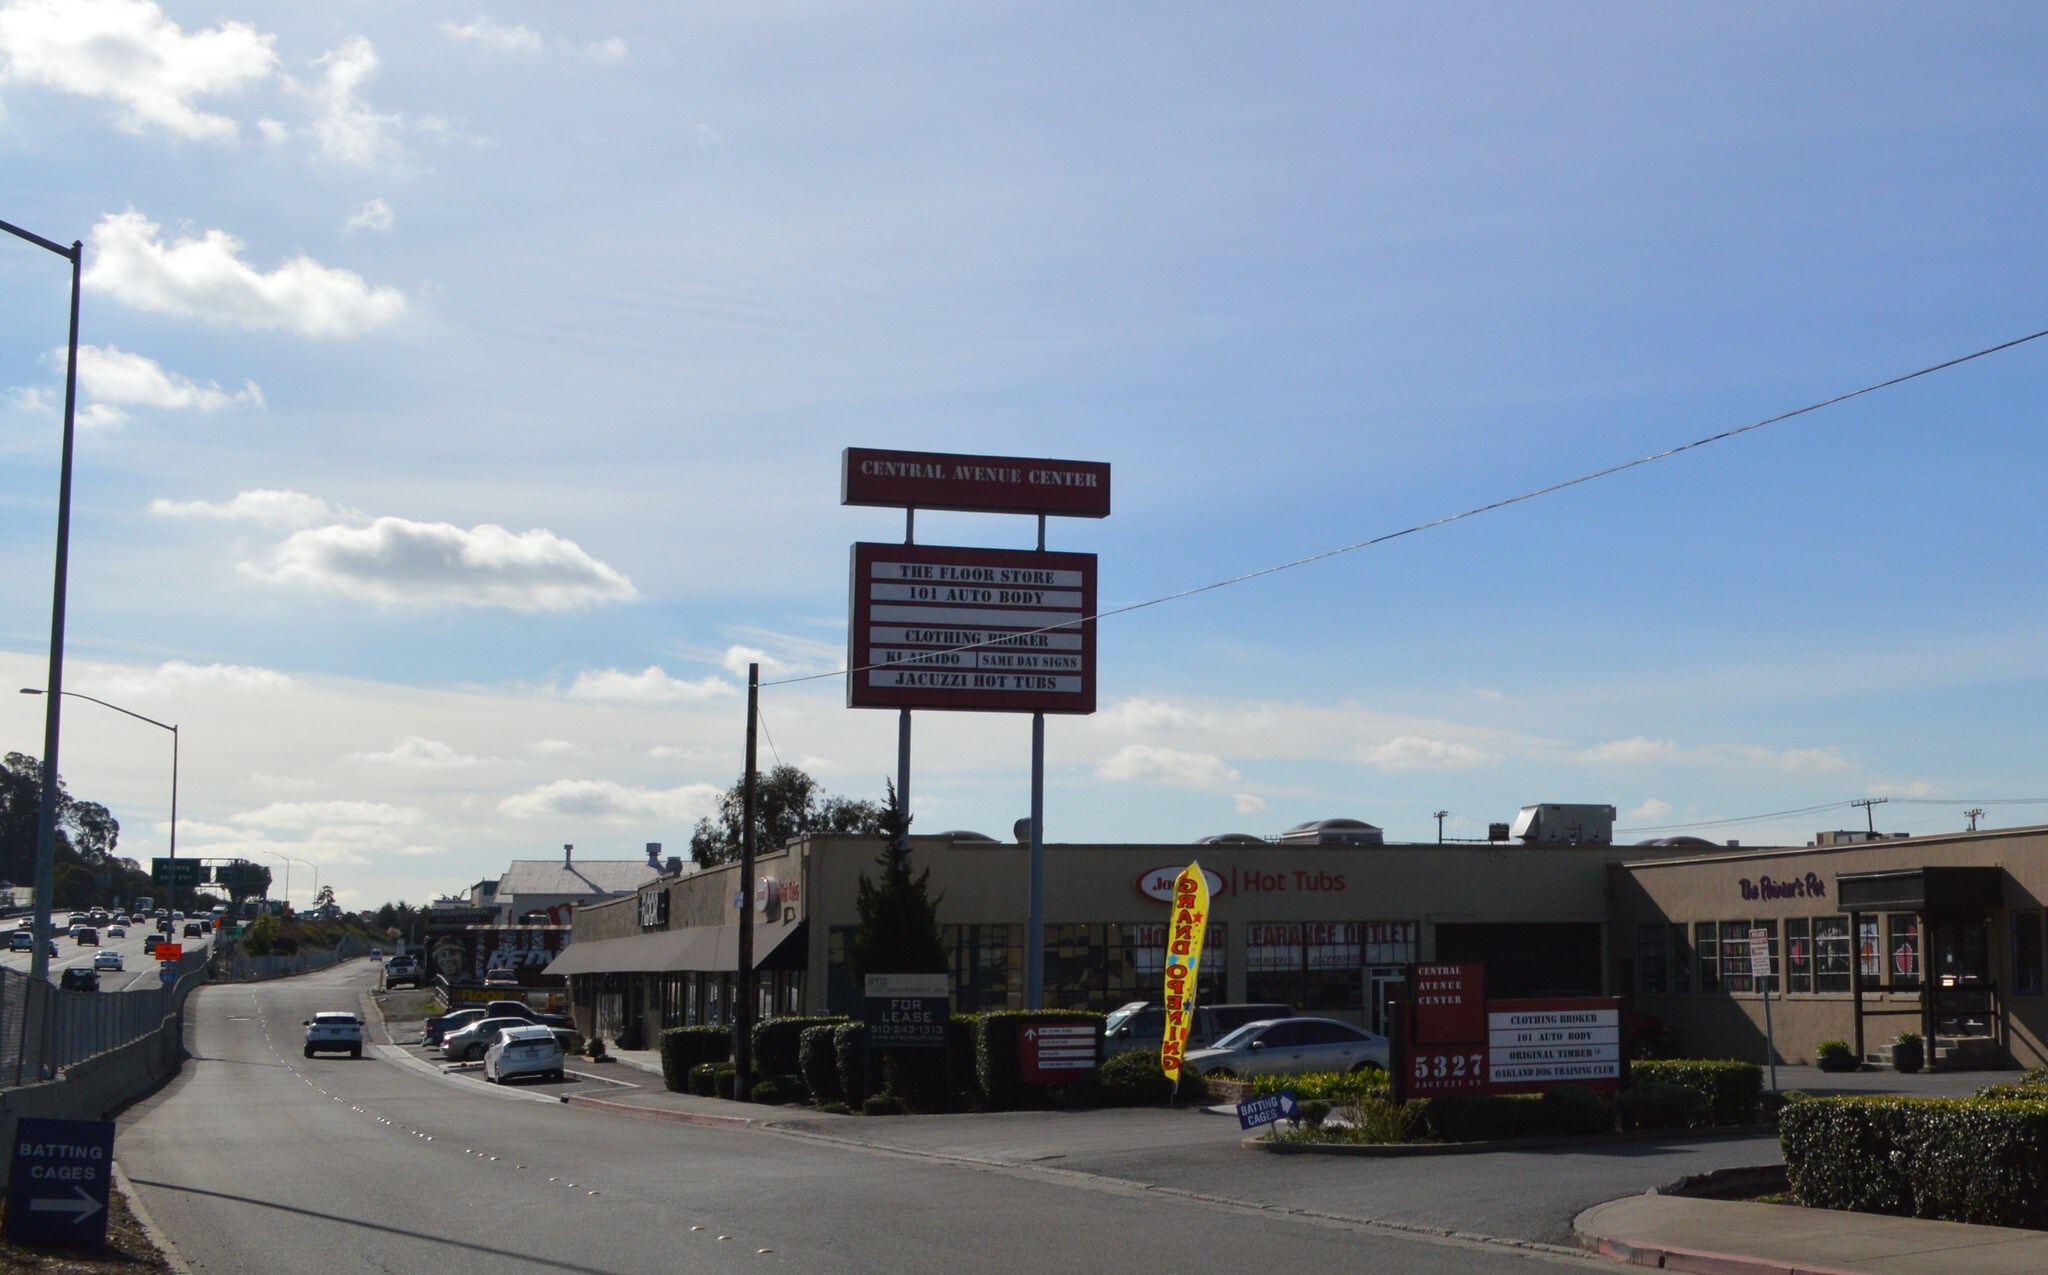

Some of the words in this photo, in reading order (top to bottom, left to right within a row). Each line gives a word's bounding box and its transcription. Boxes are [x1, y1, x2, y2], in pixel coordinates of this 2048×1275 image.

[861, 460, 945, 479] CENTRAL
[952, 465, 1021, 483] AVENUE
[1028, 469, 1098, 487] CENTER
[900, 564, 933, 579] THE
[940, 567, 995, 581] FLOOR
[1001, 570, 1054, 584] STORE
[910, 586, 937, 600] 101
[946, 588, 992, 603] AUTO
[999, 590, 1045, 605] BODY
[905, 629, 981, 645] CLOTHING
[988, 632, 1049, 647] BROKER
[908, 652, 960, 665] AIKIDO
[982, 655, 1014, 666] SAME
[1017, 656, 1038, 667] DAY
[1043, 657, 1077, 668] SIGNS
[895, 672, 967, 687] JACUZZI
[973, 674, 1007, 688] HOT
[1014, 676, 1057, 689] TUBS
[1244, 871, 1286, 891] Hot
[1292, 871, 1346, 891] Tubs
[1739, 878, 1759, 901] The
[1140, 927, 1167, 948] HO
[1418, 966, 1461, 975] CENTRAL
[1419, 981, 1462, 990] AVENUE
[891, 999, 922, 1010] FOR
[1419, 995, 1462, 1005] CENTER
[881, 1011, 933, 1023] LEASE
[1510, 1015, 1557, 1025] CLOTHING
[1560, 1014, 1597, 1023] BROKER
[1517, 1034, 1532, 1042] 101
[1539, 1032, 1563, 1042] AUTO
[1568, 1031, 1593, 1040] BODY
[1509, 1050, 1555, 1060] ORIGINAL
[1558, 1048, 1593, 1058] TIMBER
[1415, 1054, 1483, 1078] 5327
[1495, 1068, 1534, 1078] OAKLAND
[1536, 1067, 1552, 1076] DOG
[1554, 1066, 1592, 1076] TRAINING
[1594, 1065, 1615, 1074] CLUB
[1415, 1080, 1462, 1089] JACUZZI
[1240, 1096, 1278, 1116] BATTING
[1247, 1108, 1277, 1126] CAGES
[20, 1143, 103, 1160] BATTING
[31, 1165, 96, 1180] CAGES
